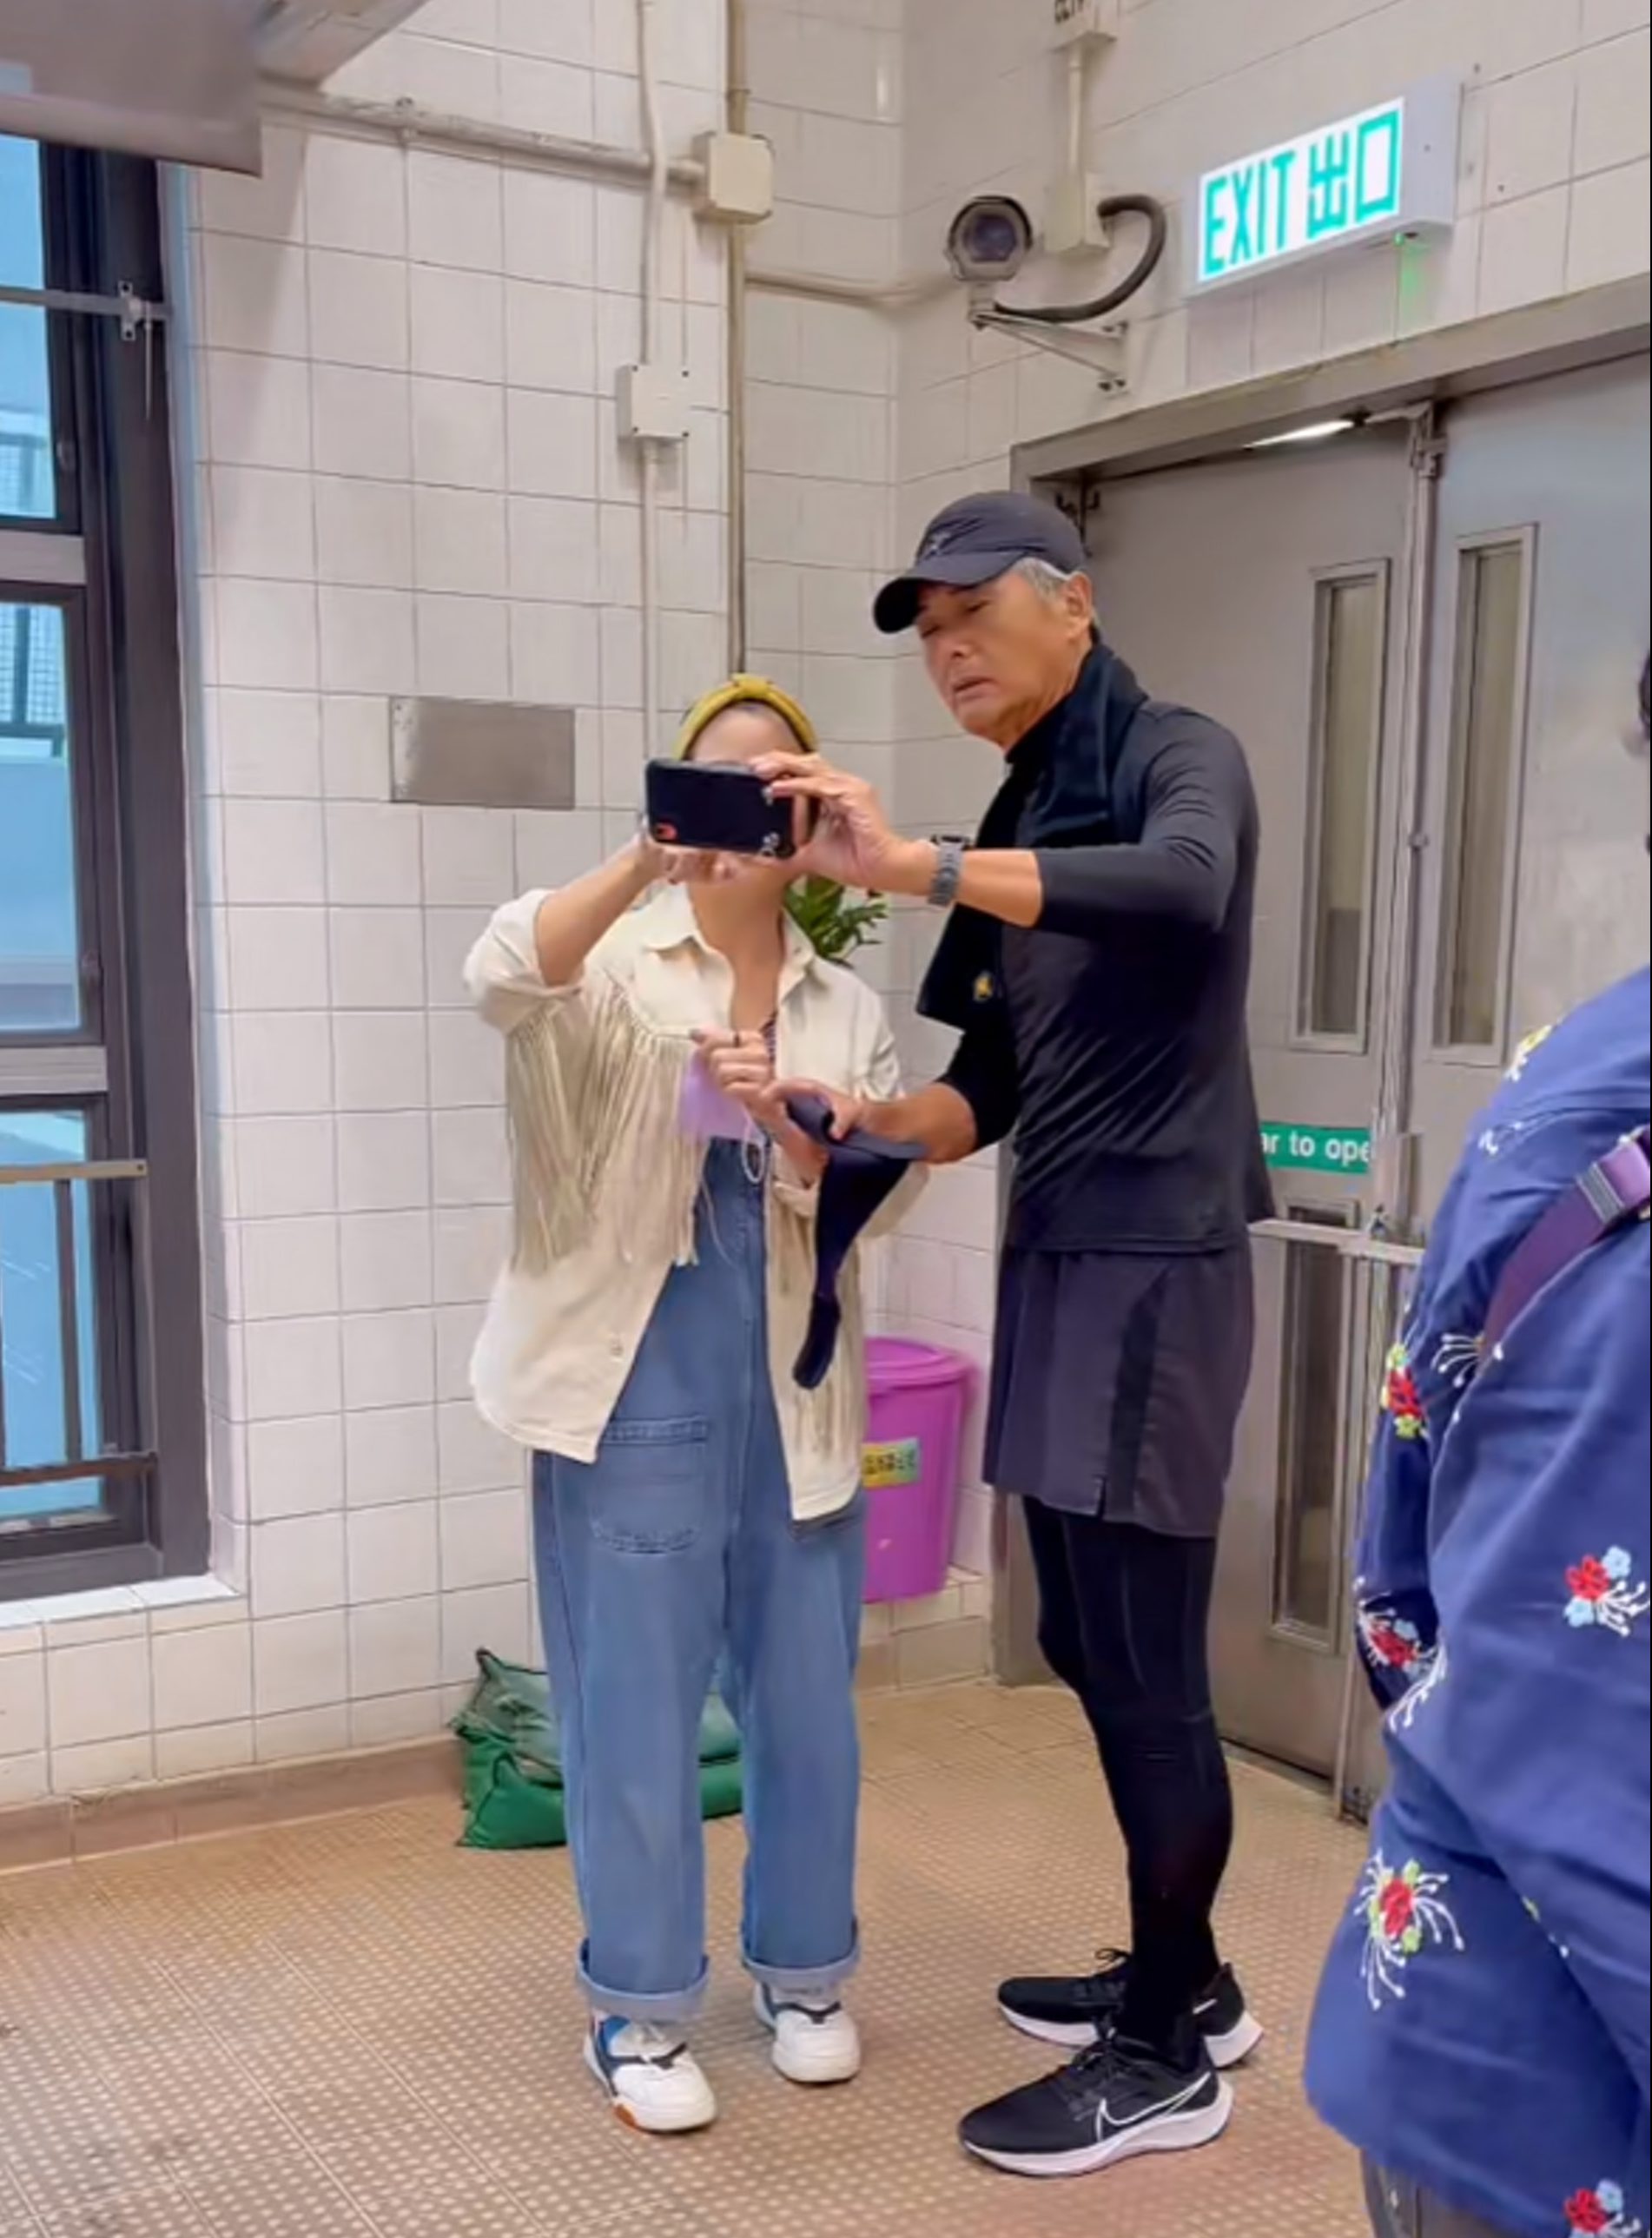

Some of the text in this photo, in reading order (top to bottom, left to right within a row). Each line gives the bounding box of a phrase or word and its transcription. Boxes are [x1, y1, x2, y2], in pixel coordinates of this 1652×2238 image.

[1204, 108, 1400, 276] EXIT 出口
[1289, 1131, 1316, 1158] to
